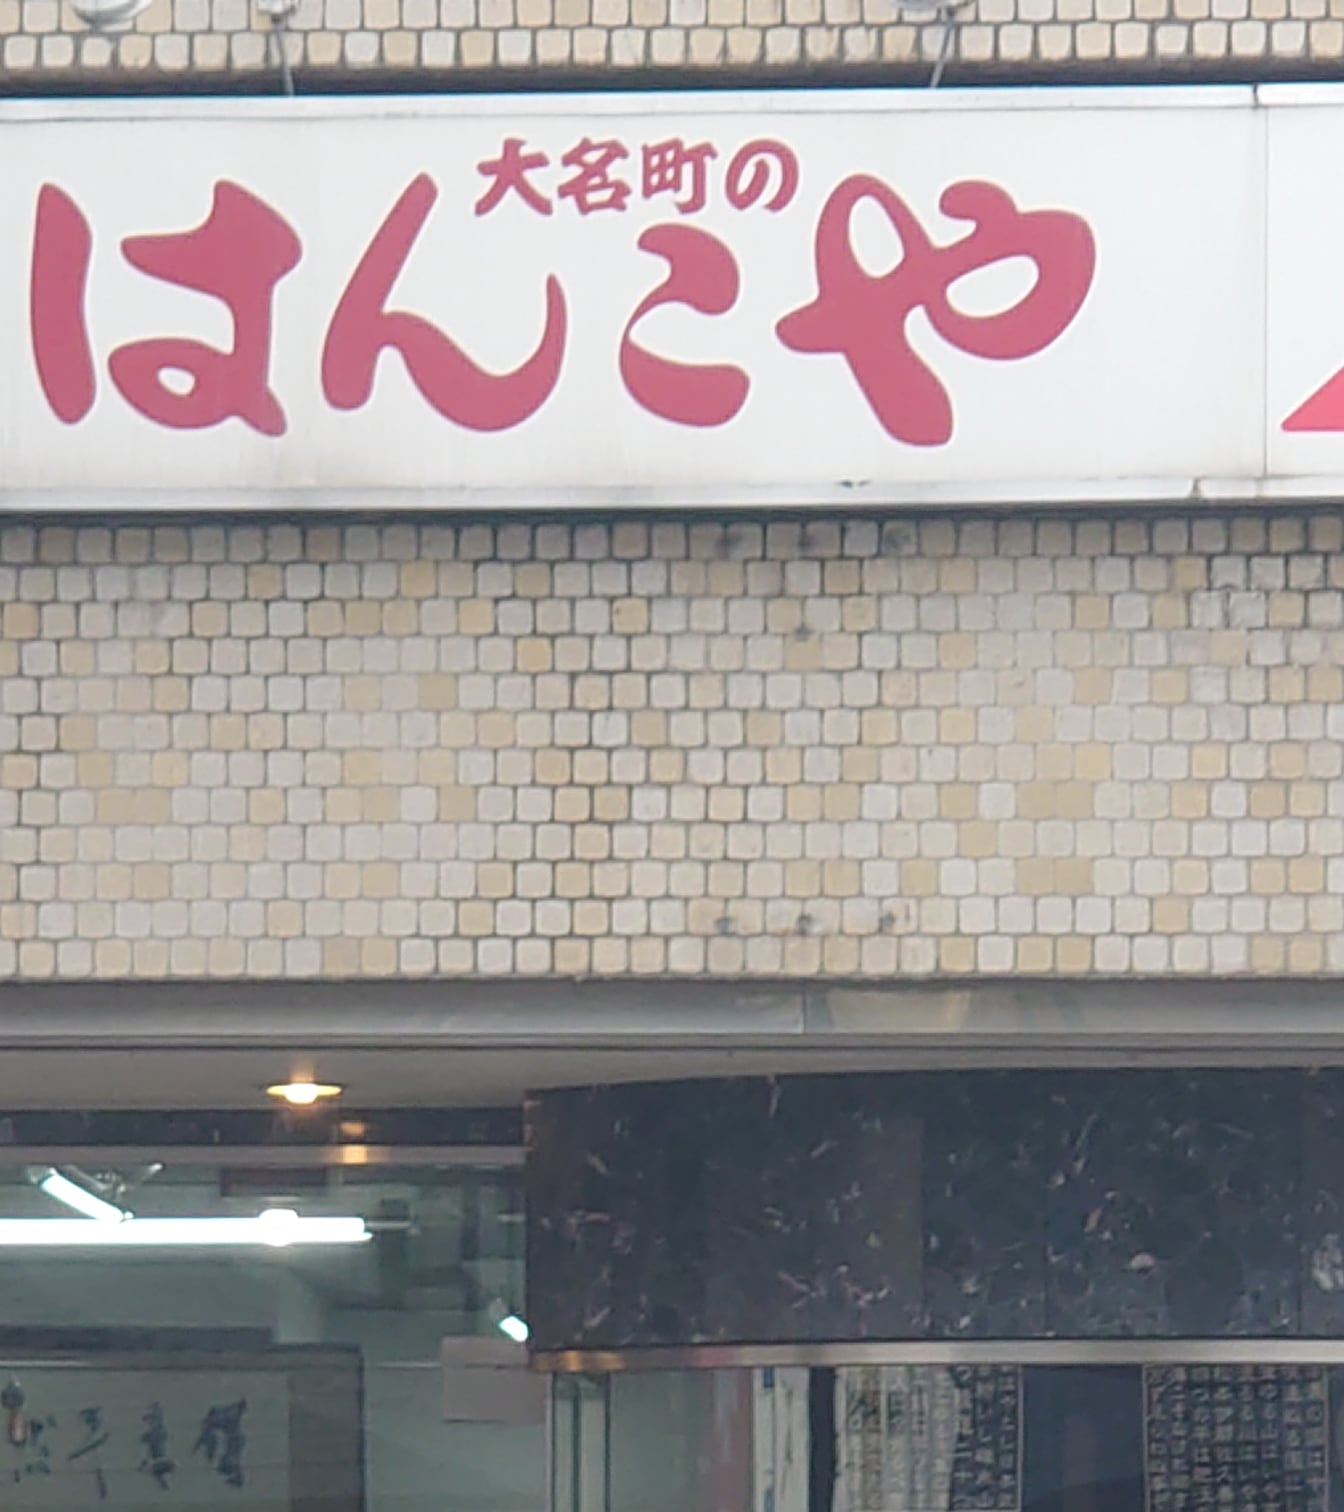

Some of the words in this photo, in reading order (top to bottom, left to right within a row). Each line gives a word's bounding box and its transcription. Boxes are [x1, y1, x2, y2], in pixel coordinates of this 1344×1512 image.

[475, 136, 799, 216] 大名町の
[29, 171, 1097, 446] はんこや
